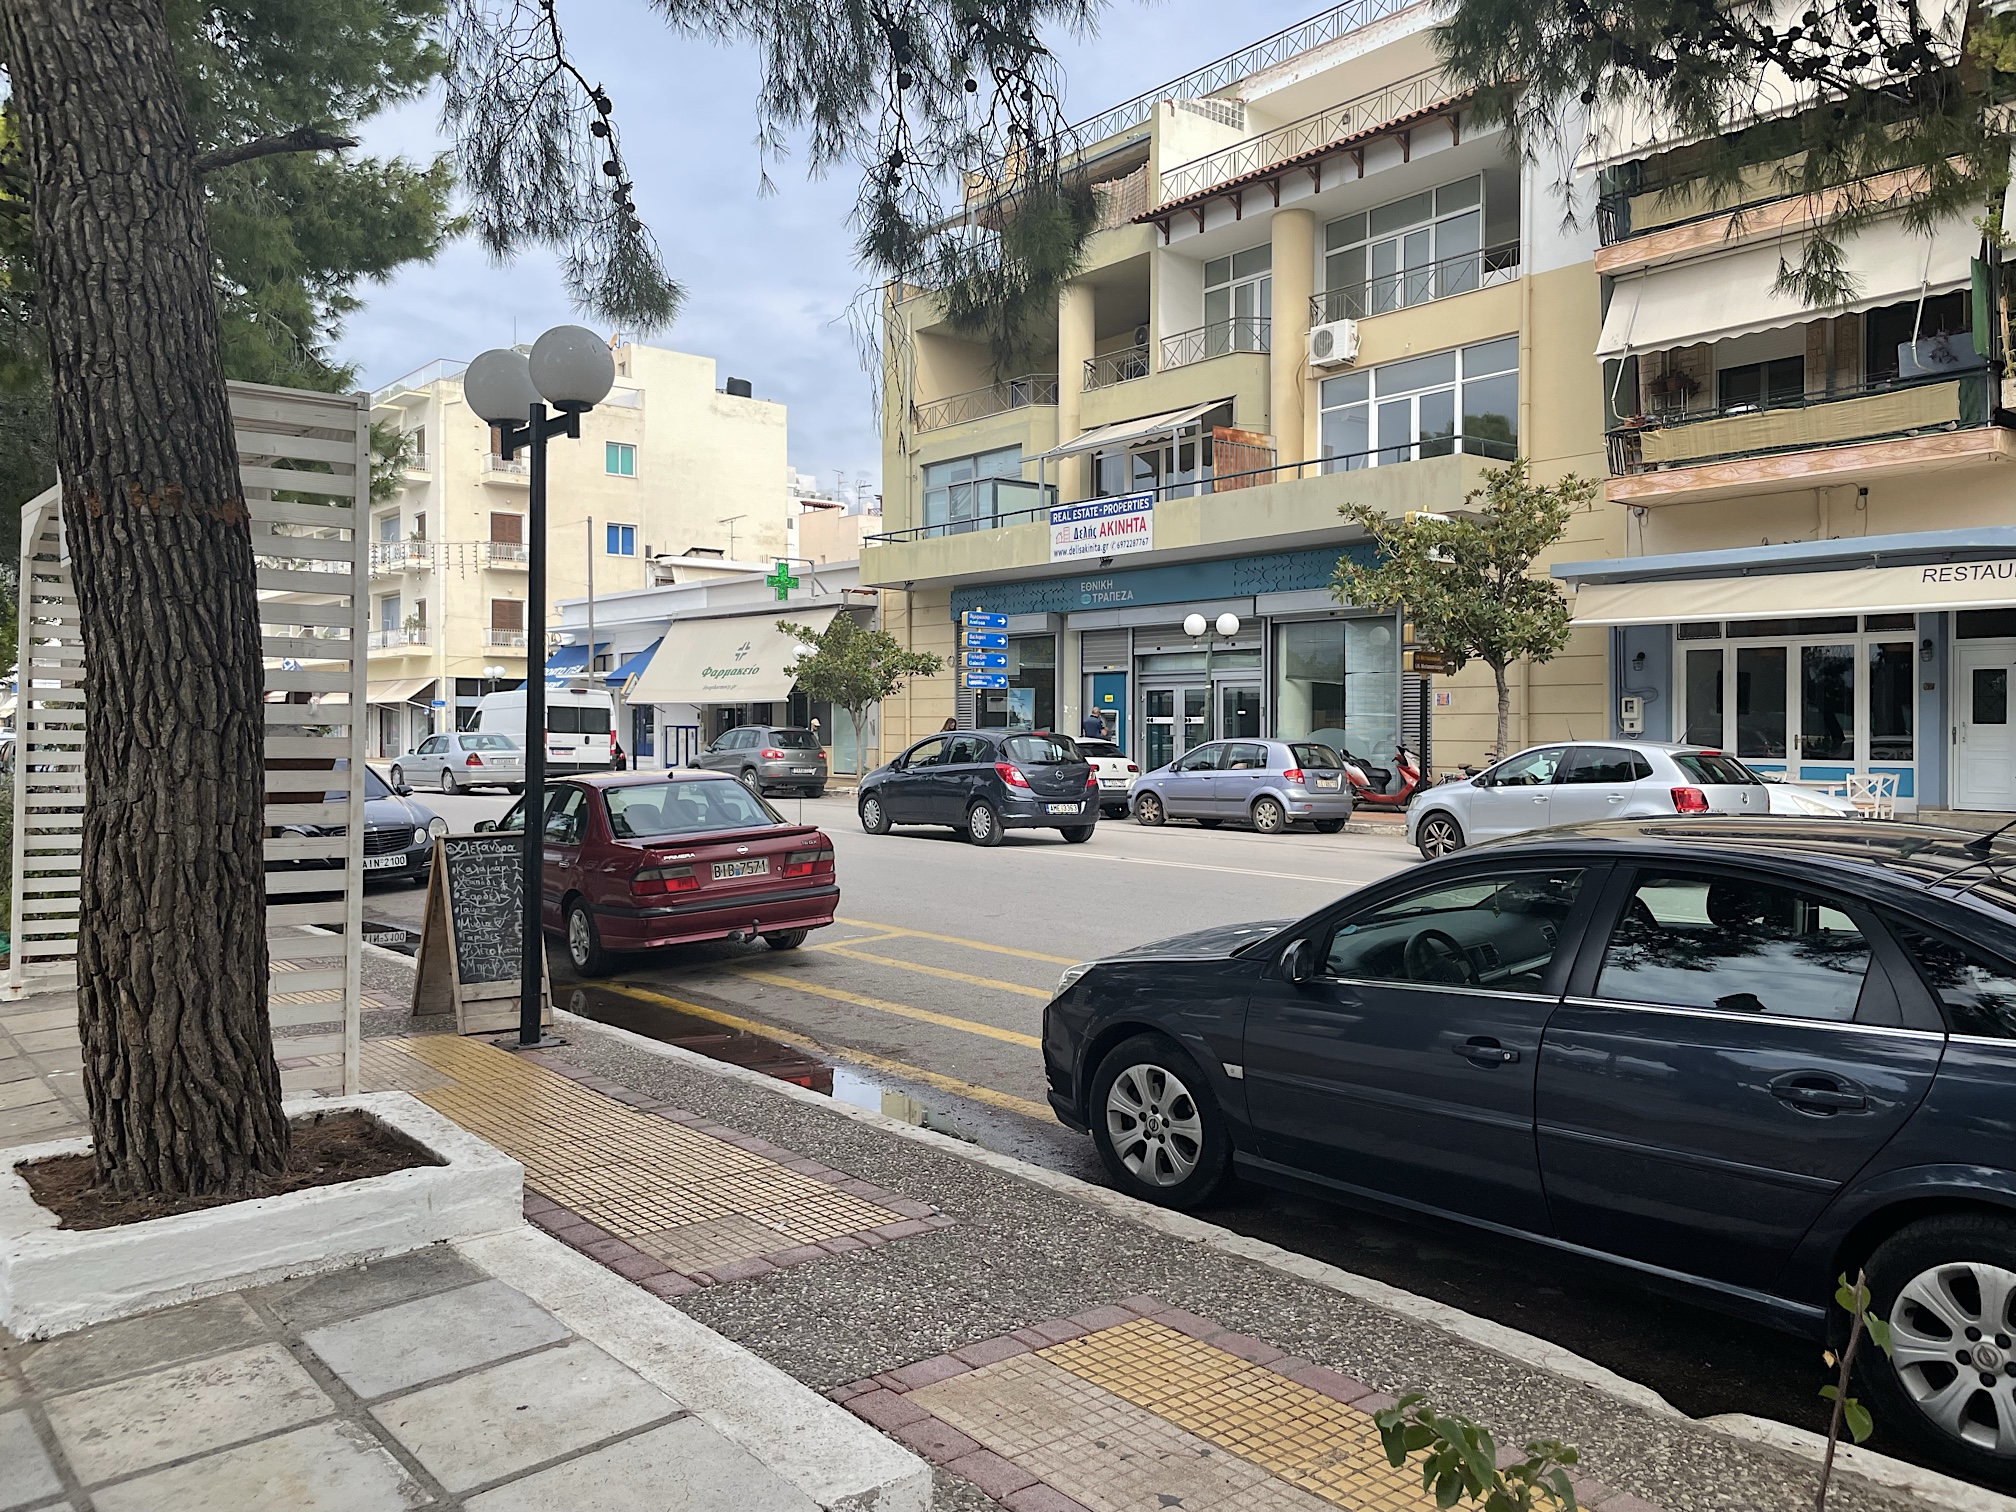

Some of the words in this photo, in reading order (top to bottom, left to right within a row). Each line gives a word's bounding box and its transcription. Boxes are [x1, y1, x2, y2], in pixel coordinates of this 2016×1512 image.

[1053, 512, 1072, 523] REAL
[1073, 525, 1097, 540] Δελής
[1099, 516, 1147, 538] ΑΚΙΝΗΤΑ
[1053, 542, 1109, 557] www.delisakinita.gr
[1116, 537, 1149, 550] 6972287767
[1922, 563, 2016, 583] RESTAU
[1080, 579, 1113, 592] ΕΘΝΙΚΗ
[1092, 590, 1134, 603] ΤΡΑΠΕΖΑ
[701, 664, 760, 680] Φαρμακείο
[663, 852, 696, 861] PRIMERA
